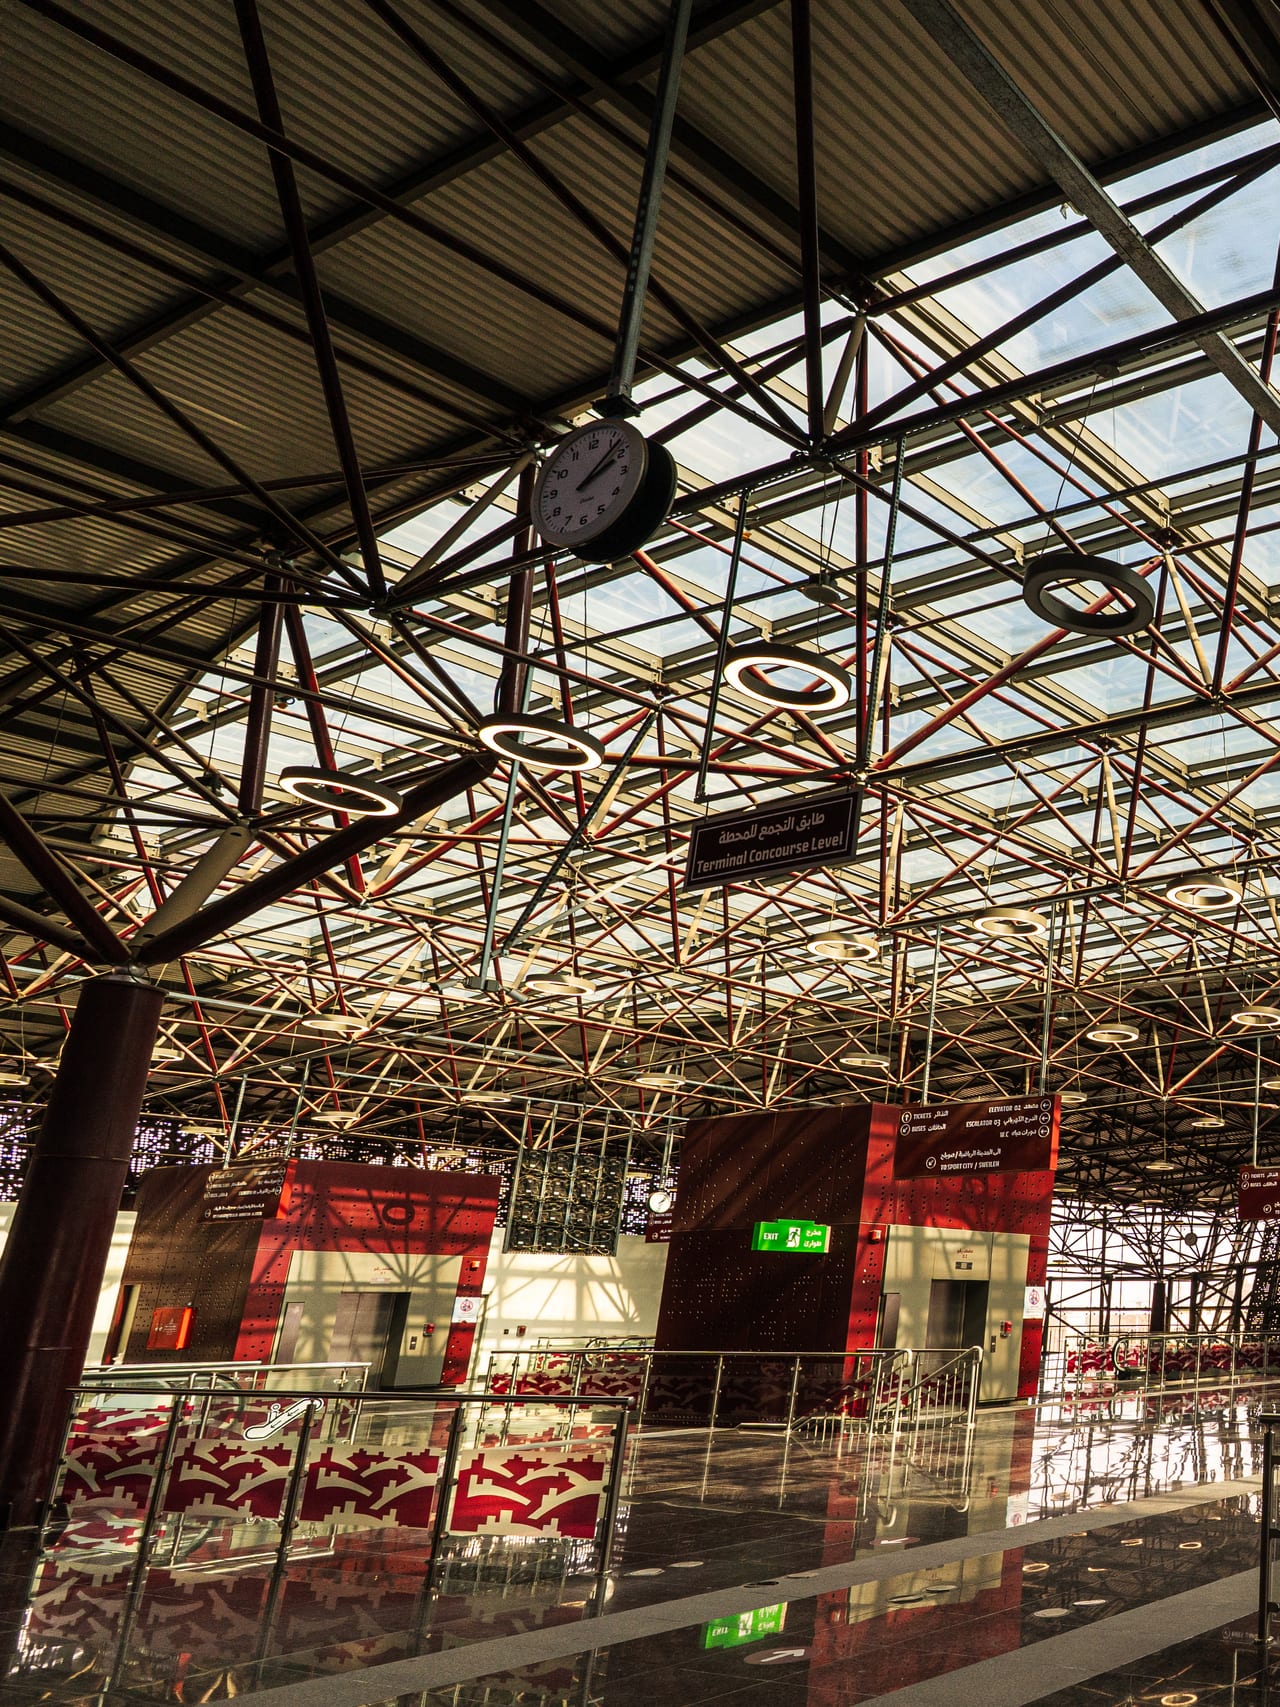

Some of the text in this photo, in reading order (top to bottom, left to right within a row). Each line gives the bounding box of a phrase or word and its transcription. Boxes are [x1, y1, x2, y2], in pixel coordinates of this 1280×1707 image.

[588, 439, 600, 451] 12
[571, 451, 580, 462] 11
[617, 449, 625, 459] 2
[556, 469, 569, 480] 10
[620, 465, 628, 476] 3
[550, 490, 558, 499] 9
[612, 486, 620, 496] 4
[553, 507, 561, 517] 8
[597, 504, 605, 515] 5
[565, 515, 573, 526] 7
[579, 515, 588, 525] 6
[719, 812, 825, 844] طابق التجمع للمحطة
[696, 831, 844, 873] Terminal Concourse Level
[913, 1112, 932, 1120] TICKETS
[966, 1120, 992, 1128] ESCALATOR
[763, 1232, 779, 1240] EXIT
[806, 1229, 822, 1237] مخرج
